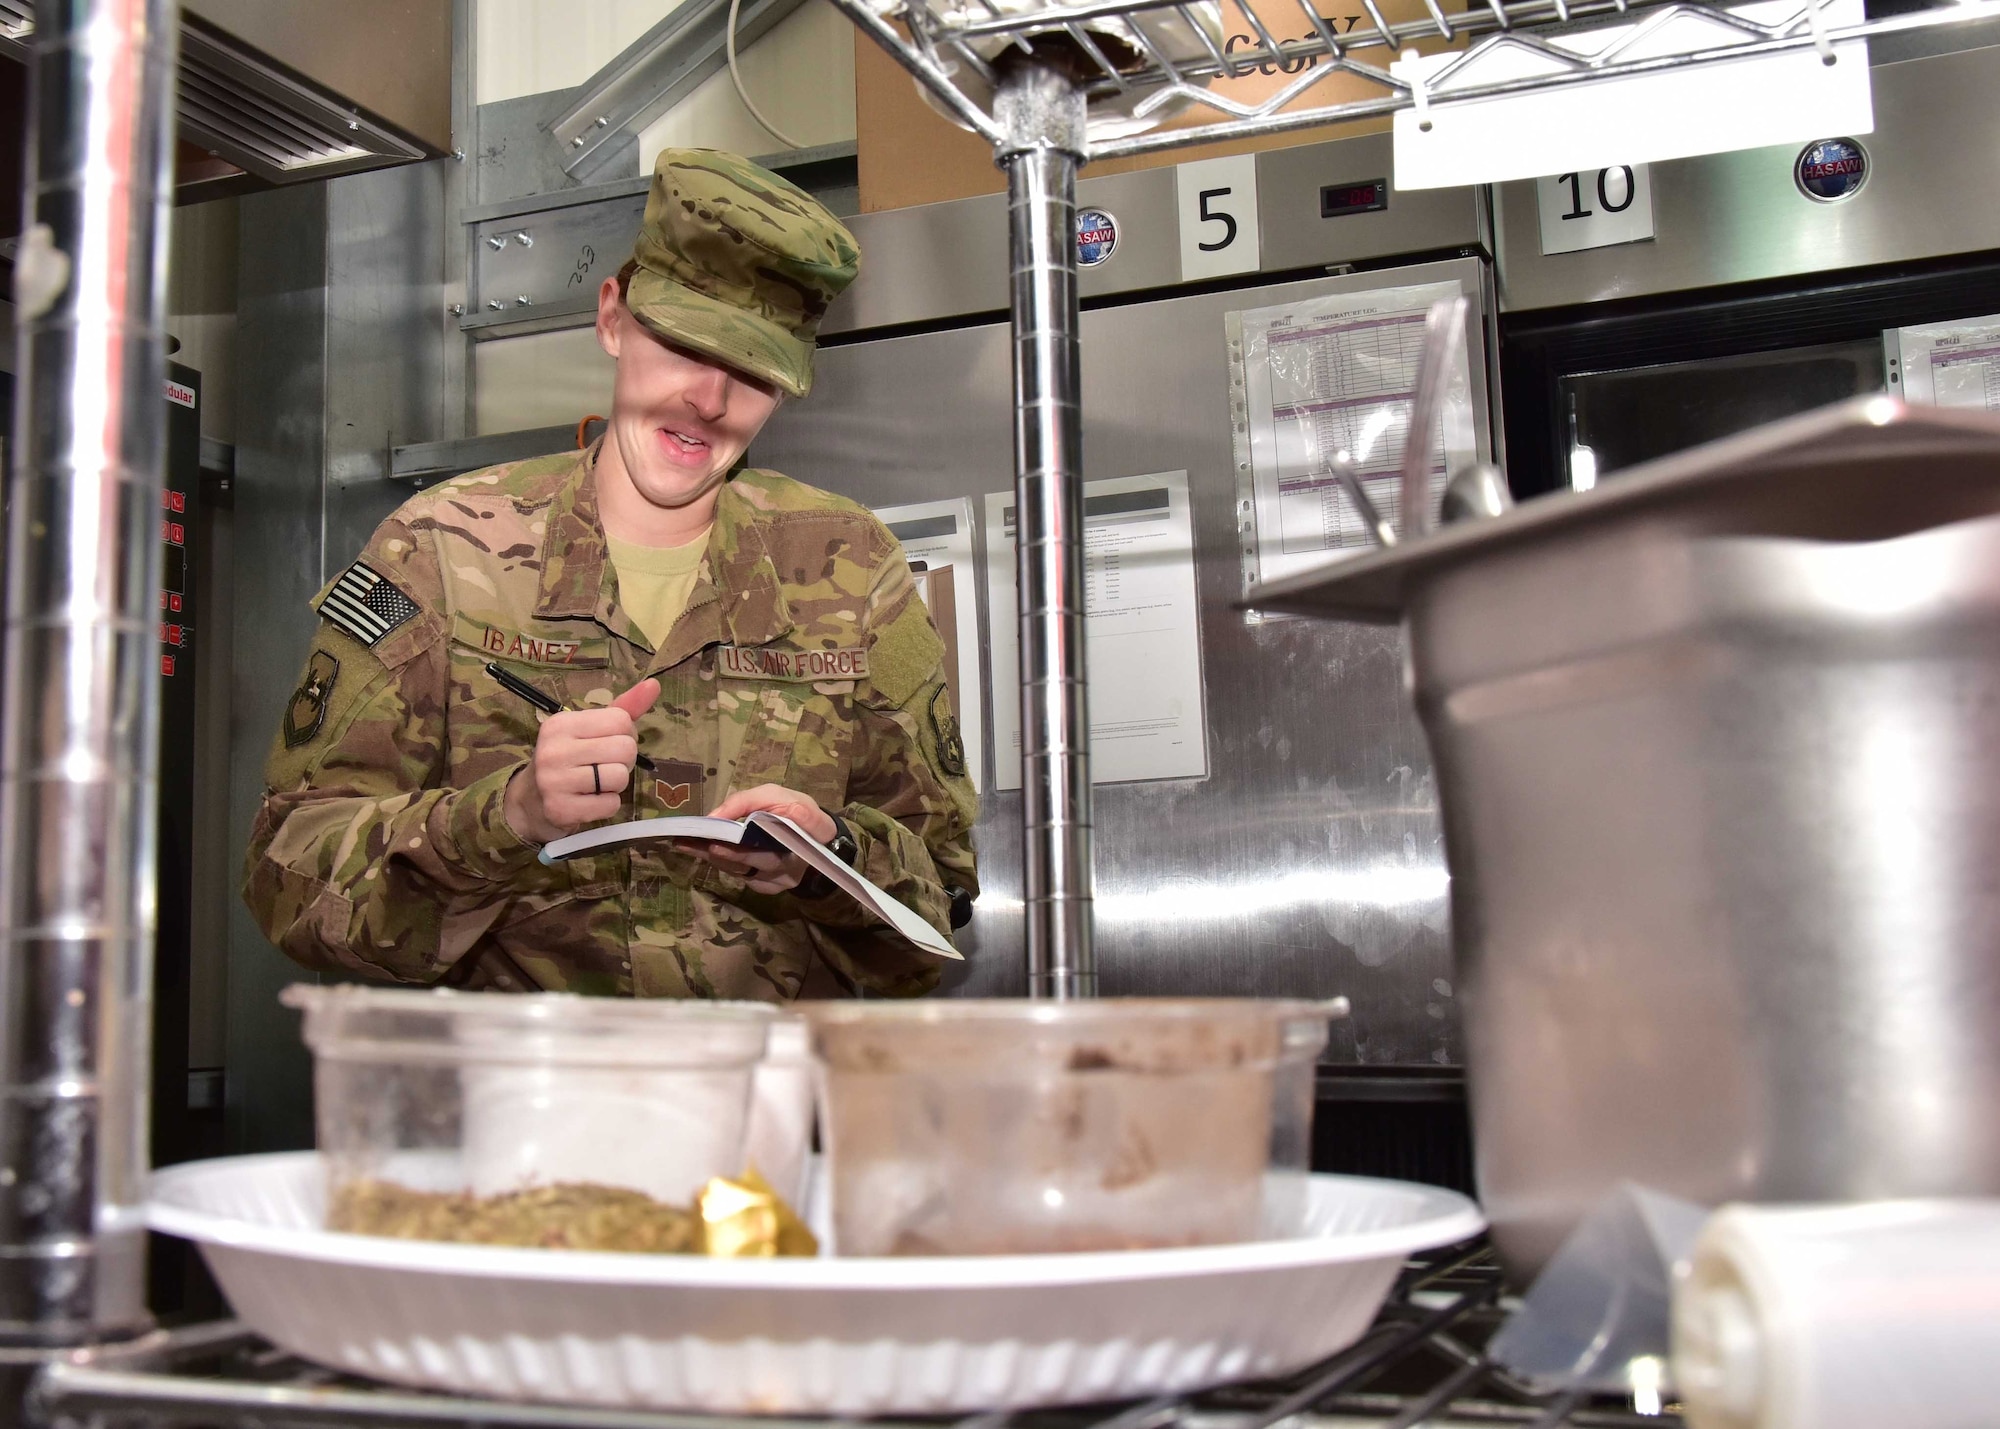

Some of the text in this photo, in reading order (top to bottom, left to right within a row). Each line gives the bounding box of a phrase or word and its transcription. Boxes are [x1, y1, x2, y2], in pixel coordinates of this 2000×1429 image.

[1803, 159, 1863, 179] HASAWI
[1558, 164, 1635, 221] 10
[1198, 187, 1237, 251] 5
[1076, 229, 1114, 244] ASAWI
[1312, 307, 1378, 322] TEMPERATURE LOG
[162, 385, 193, 403] odular
[483, 626, 579, 664] IBANEZ
[725, 648, 866, 677] U.S. AIR FORCE
